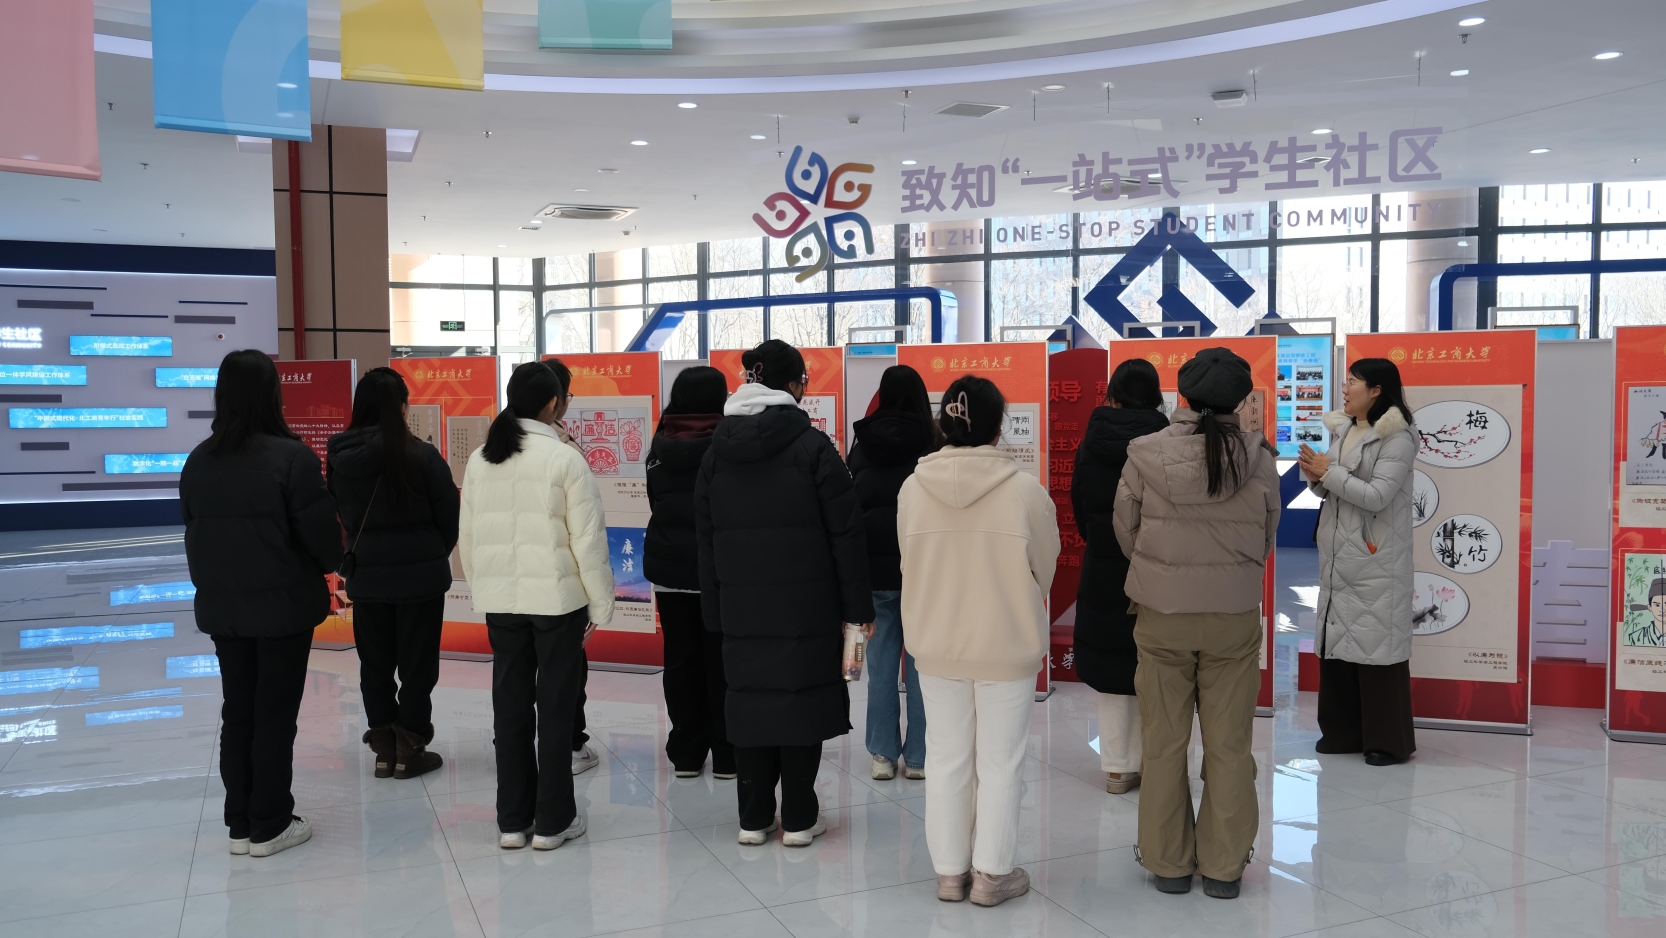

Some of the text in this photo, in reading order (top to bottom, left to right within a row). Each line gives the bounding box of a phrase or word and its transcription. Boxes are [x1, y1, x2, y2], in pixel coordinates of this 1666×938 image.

[901, 127, 1443, 214] 致知“一站式”学生社区
[901, 203, 1442, 248] ZHI ZHI ONE-STOP STUDENT COMMUNITY
[1466, 410, 1489, 430] 梅
[1468, 545, 1488, 562] 竹
